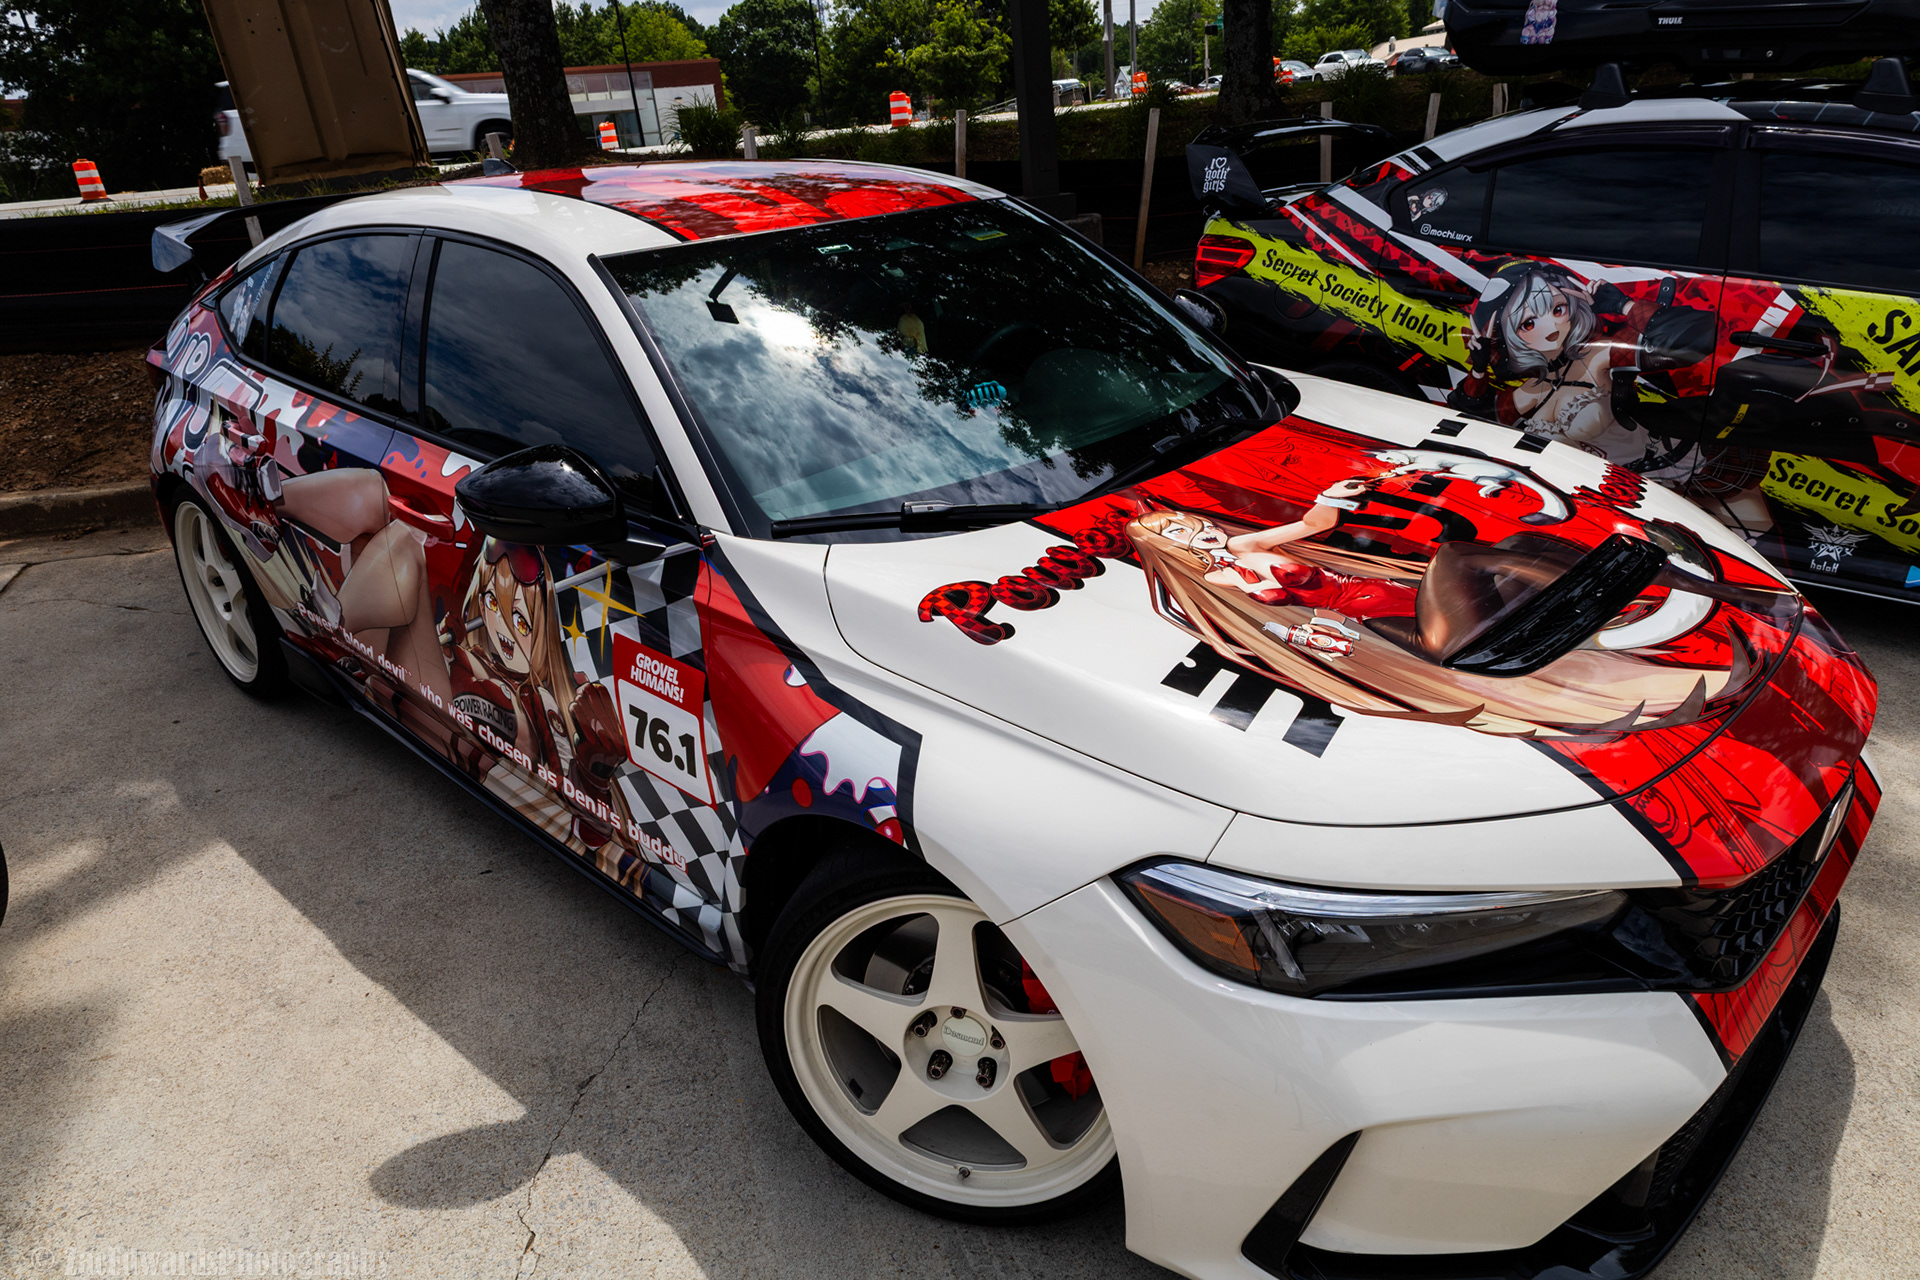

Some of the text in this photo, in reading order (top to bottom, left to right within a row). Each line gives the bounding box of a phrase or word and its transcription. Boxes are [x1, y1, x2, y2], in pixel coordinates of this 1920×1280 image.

[1658, 16, 1683, 25] THULE
[1202, 179, 1226, 193] girls
[1205, 167, 1227, 182] goth
[1262, 248, 1457, 346] Secret Society HoloX
[1769, 458, 1871, 517] Secret
[630, 665, 685, 704] HUMANS!
[635, 652, 679, 686] GROVEL
[453, 697, 515, 732] POWER RACING
[296, 601, 334, 634] Power
[419, 682, 442, 709] who
[448, 703, 474, 732] was
[478, 724, 533, 771] chosen
[537, 763, 558, 790] as
[563, 776, 621, 831] Denji's
[627, 818, 688, 874] buddy
[628, 703, 697, 779] 76.1
